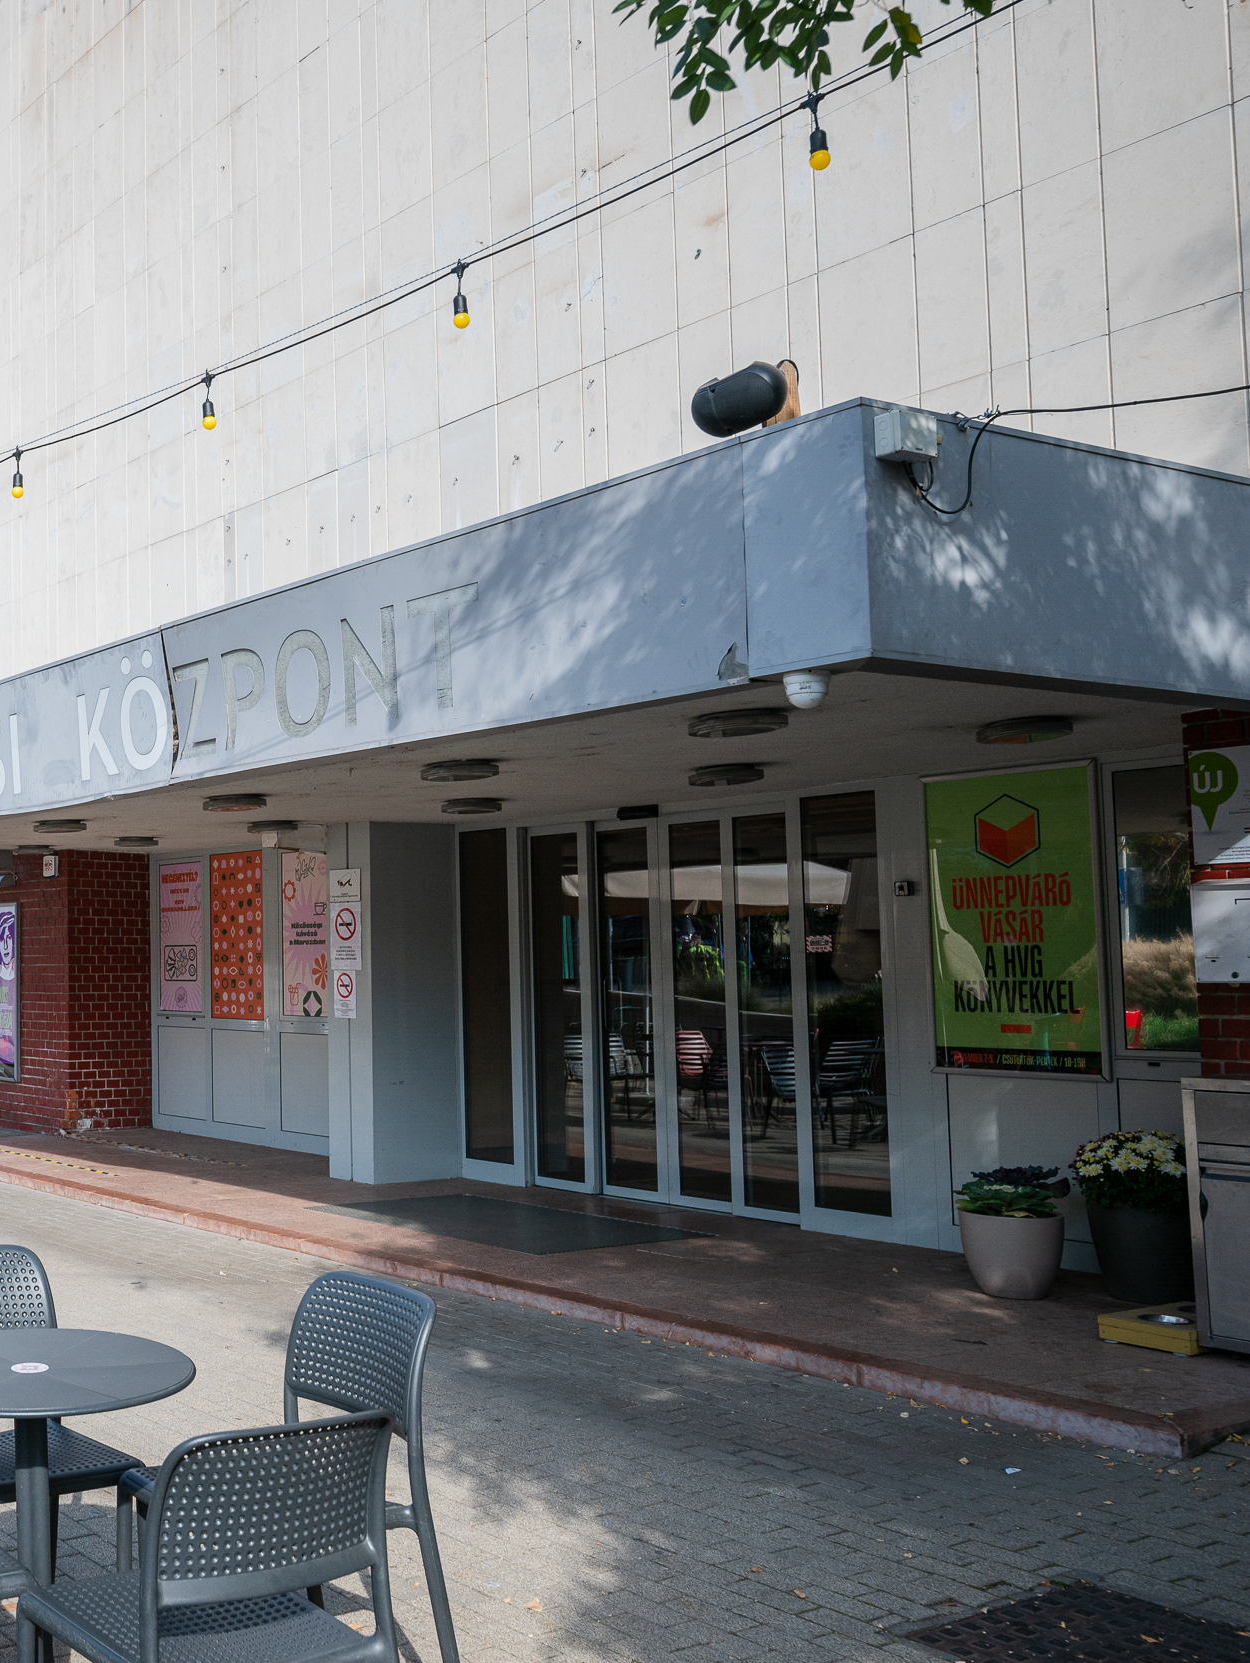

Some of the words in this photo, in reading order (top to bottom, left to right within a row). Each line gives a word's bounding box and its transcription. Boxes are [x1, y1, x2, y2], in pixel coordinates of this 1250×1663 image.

[76, 581, 479, 780] KÖZPONT
[1193, 765, 1223, 793] ÚJ
[952, 872, 1072, 911] ÜNNEPVÁRÓ
[979, 909, 1044, 944] VÁSÁR
[985, 945, 997, 978] A
[1004, 944, 1043, 978] HVG
[954, 980, 1080, 1014] KÖNYVEKKEL
